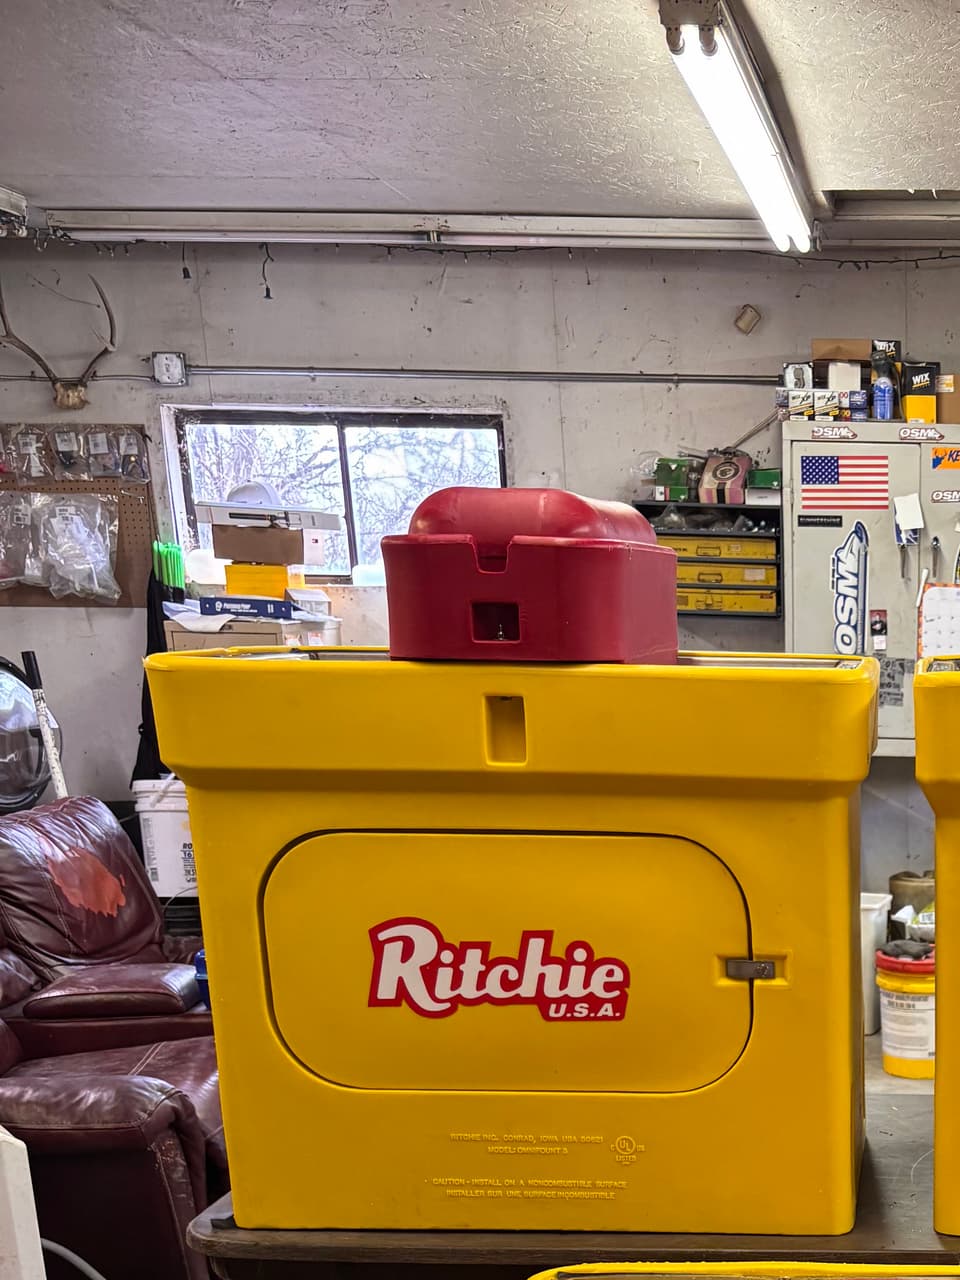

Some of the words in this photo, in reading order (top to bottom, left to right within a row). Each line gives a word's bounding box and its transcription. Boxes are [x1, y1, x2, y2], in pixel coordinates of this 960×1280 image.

[911, 372, 930, 385] WIX
[835, 555, 858, 654] OSM
[376, 923, 624, 1012] Ritchie
[548, 1003, 621, 1018] U.S.A.
[432, 1178, 465, 1186] CAUTION
